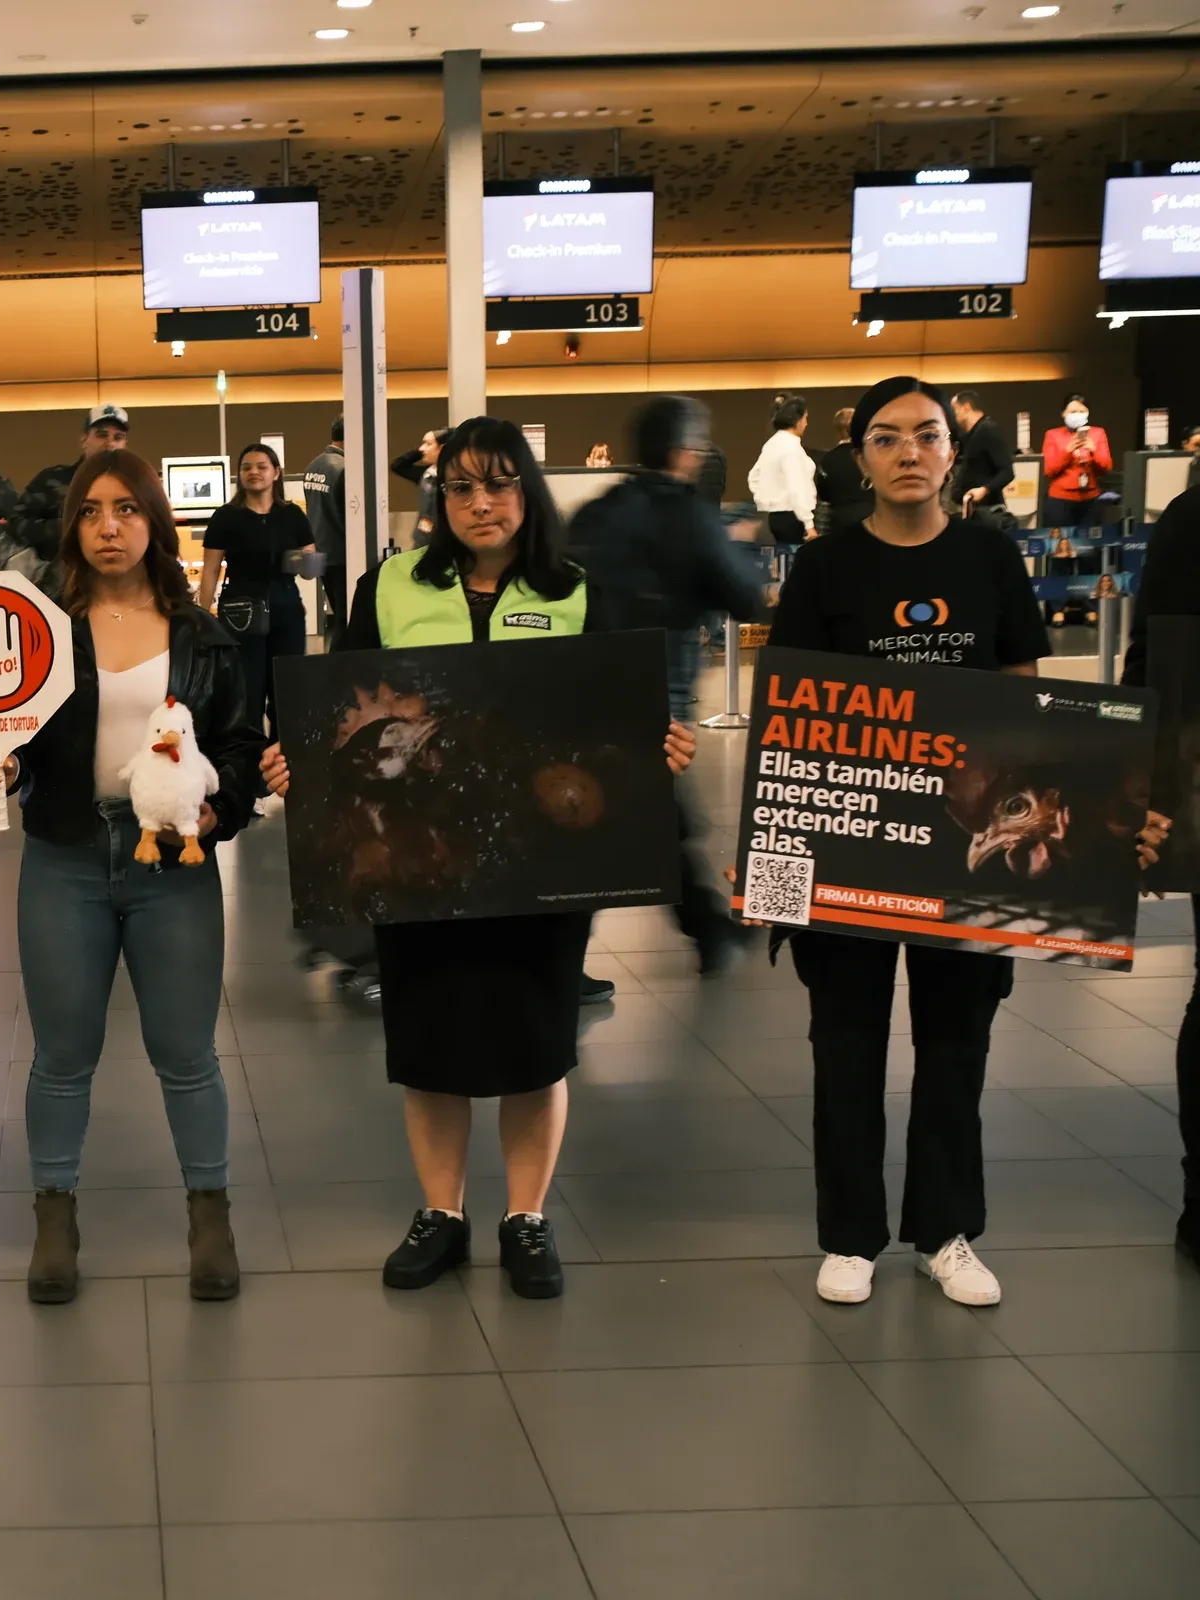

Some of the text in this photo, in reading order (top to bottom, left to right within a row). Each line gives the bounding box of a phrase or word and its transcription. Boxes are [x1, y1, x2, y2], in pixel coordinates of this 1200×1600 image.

[916, 199, 986, 214] LATAM
[211, 222, 262, 233] LATAM
[540, 213, 606, 228] LATAM
[507, 243, 621, 258] Check-in Premium
[586, 304, 628, 323] 103
[959, 294, 1002, 314] 102
[256, 314, 300, 333] 104
[868, 633, 976, 652] MERCY FOR
[768, 674, 916, 722] LATAM
[0, 718, 8, 732] DE
[9, 716, 40, 731] TORTURA
[760, 715, 968, 769] AIRLINES:
[759, 751, 944, 796] Ellas también
[756, 780, 878, 813] merecen
[753, 806, 932, 845] extender sus
[750, 827, 813, 856] alas.
[816, 888, 939, 914] FIRMA LA PETICIÓN
[1036, 938, 1126, 956] #LatamDéjalasVolar
